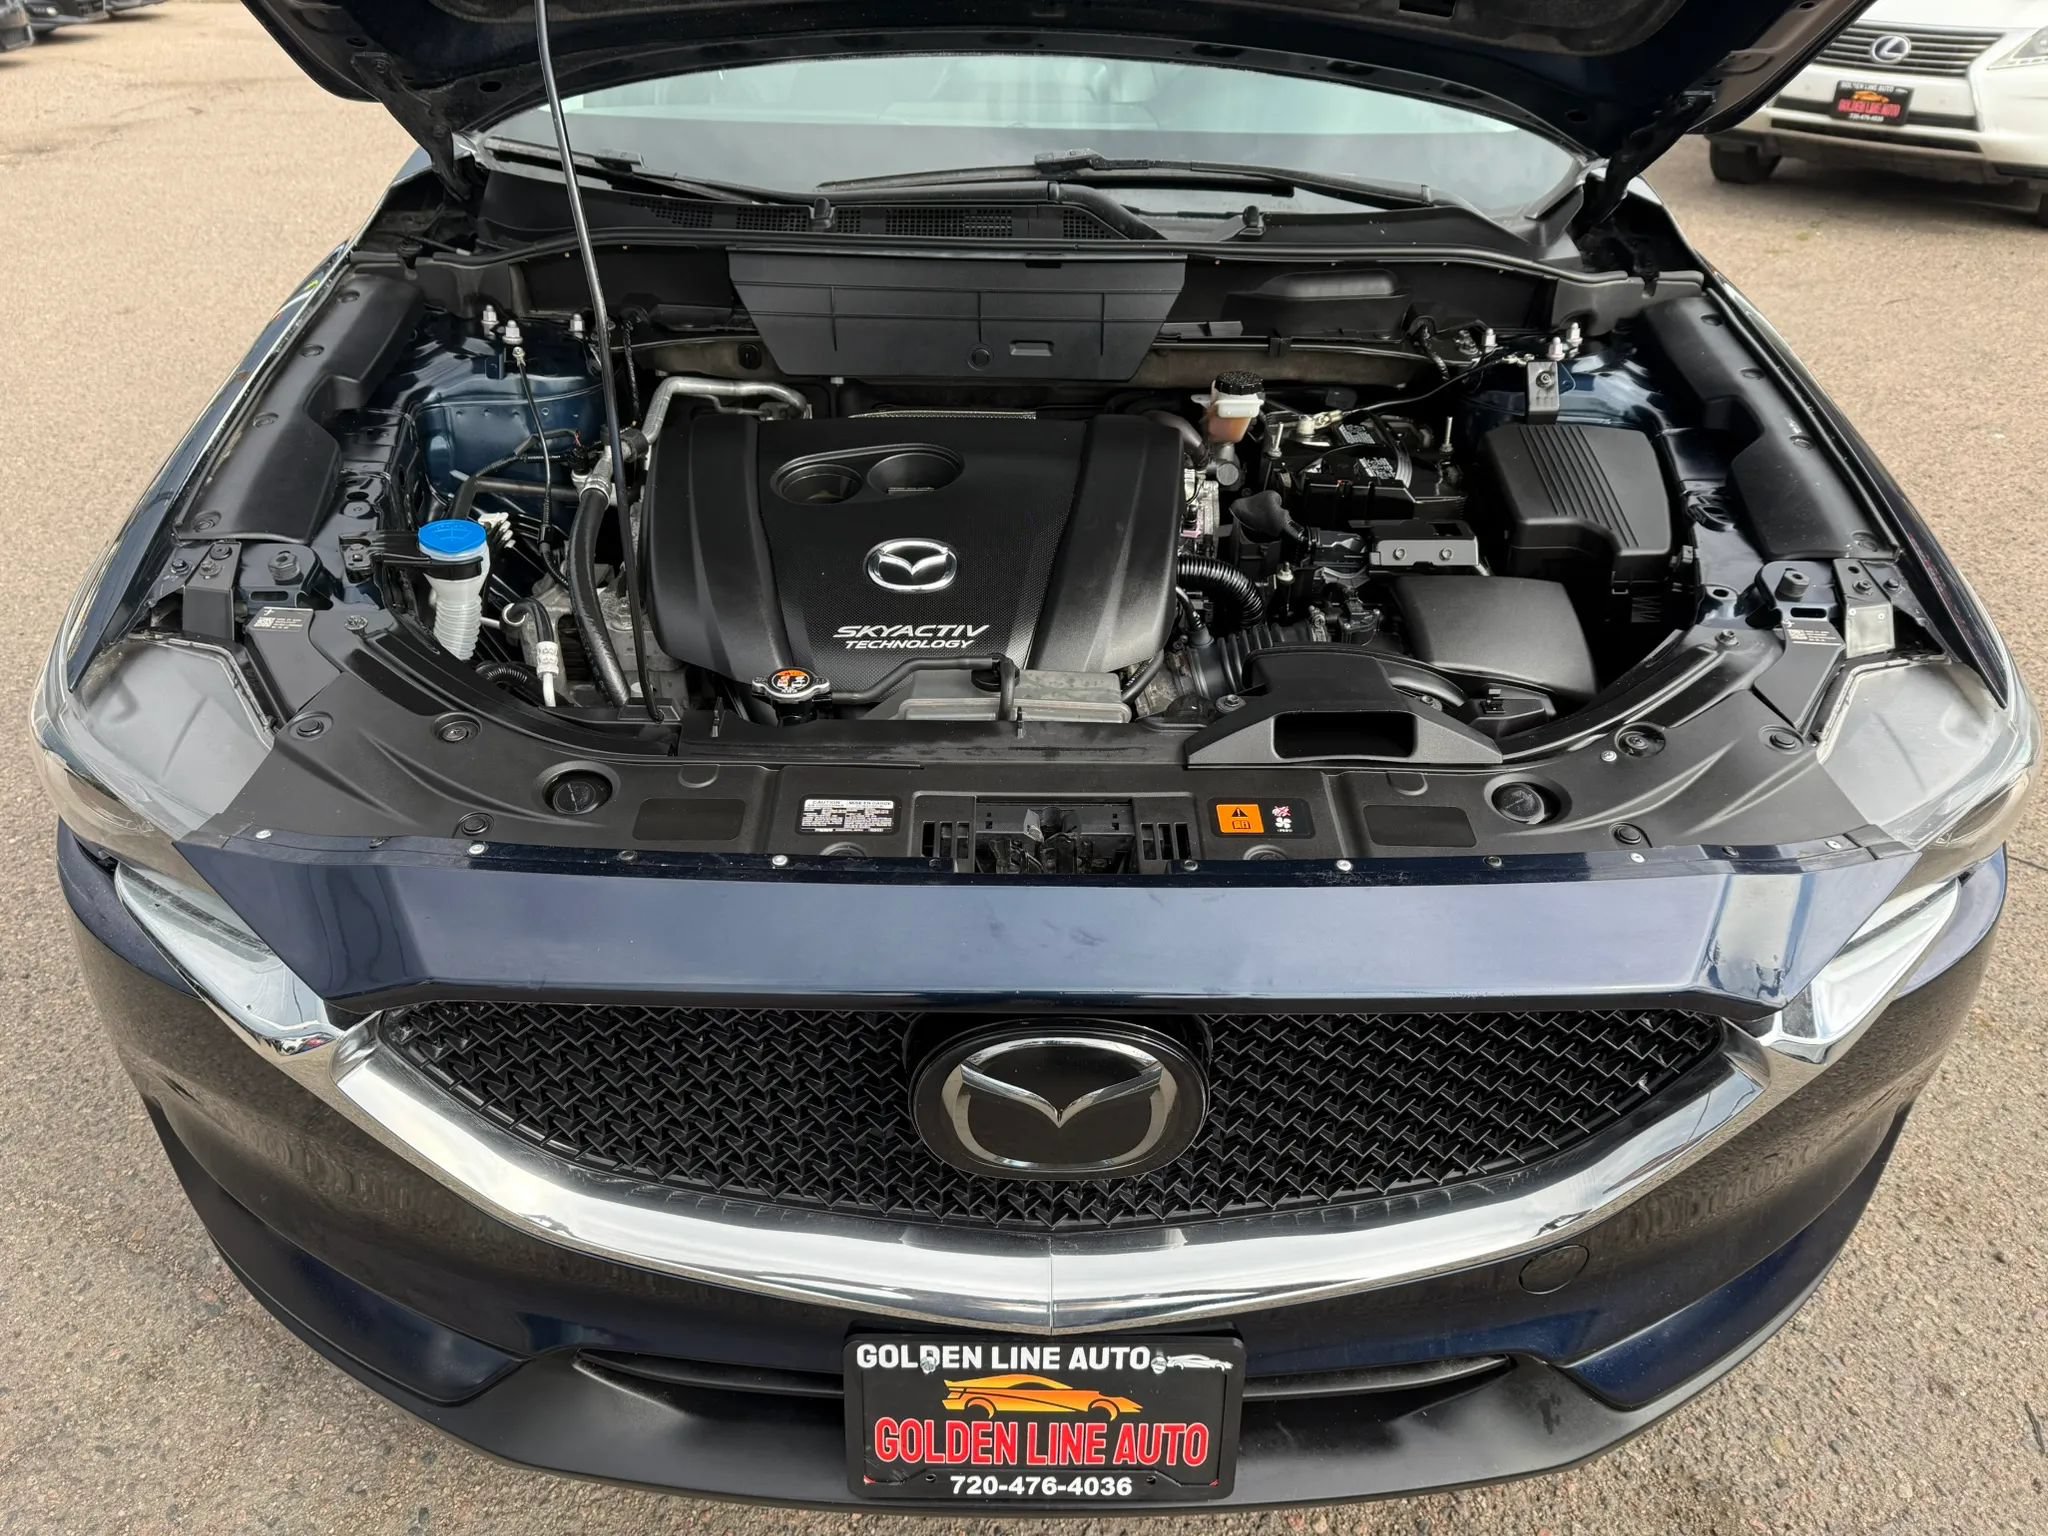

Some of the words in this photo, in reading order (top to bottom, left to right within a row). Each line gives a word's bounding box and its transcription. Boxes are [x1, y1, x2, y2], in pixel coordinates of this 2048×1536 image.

[832, 624, 990, 638] SKYACTIV
[845, 639, 974, 649] TECHNOLOGY
[857, 1344, 982, 1370] GOLDEN
[992, 1346, 1060, 1370] LINE
[1068, 1346, 1150, 1371] AUTO
[874, 1417, 1017, 1465] GOLDEN
[1027, 1423, 1106, 1466] LINE
[1114, 1423, 1209, 1467] AUTO
[950, 1475, 1133, 1497] 720-476-4036
